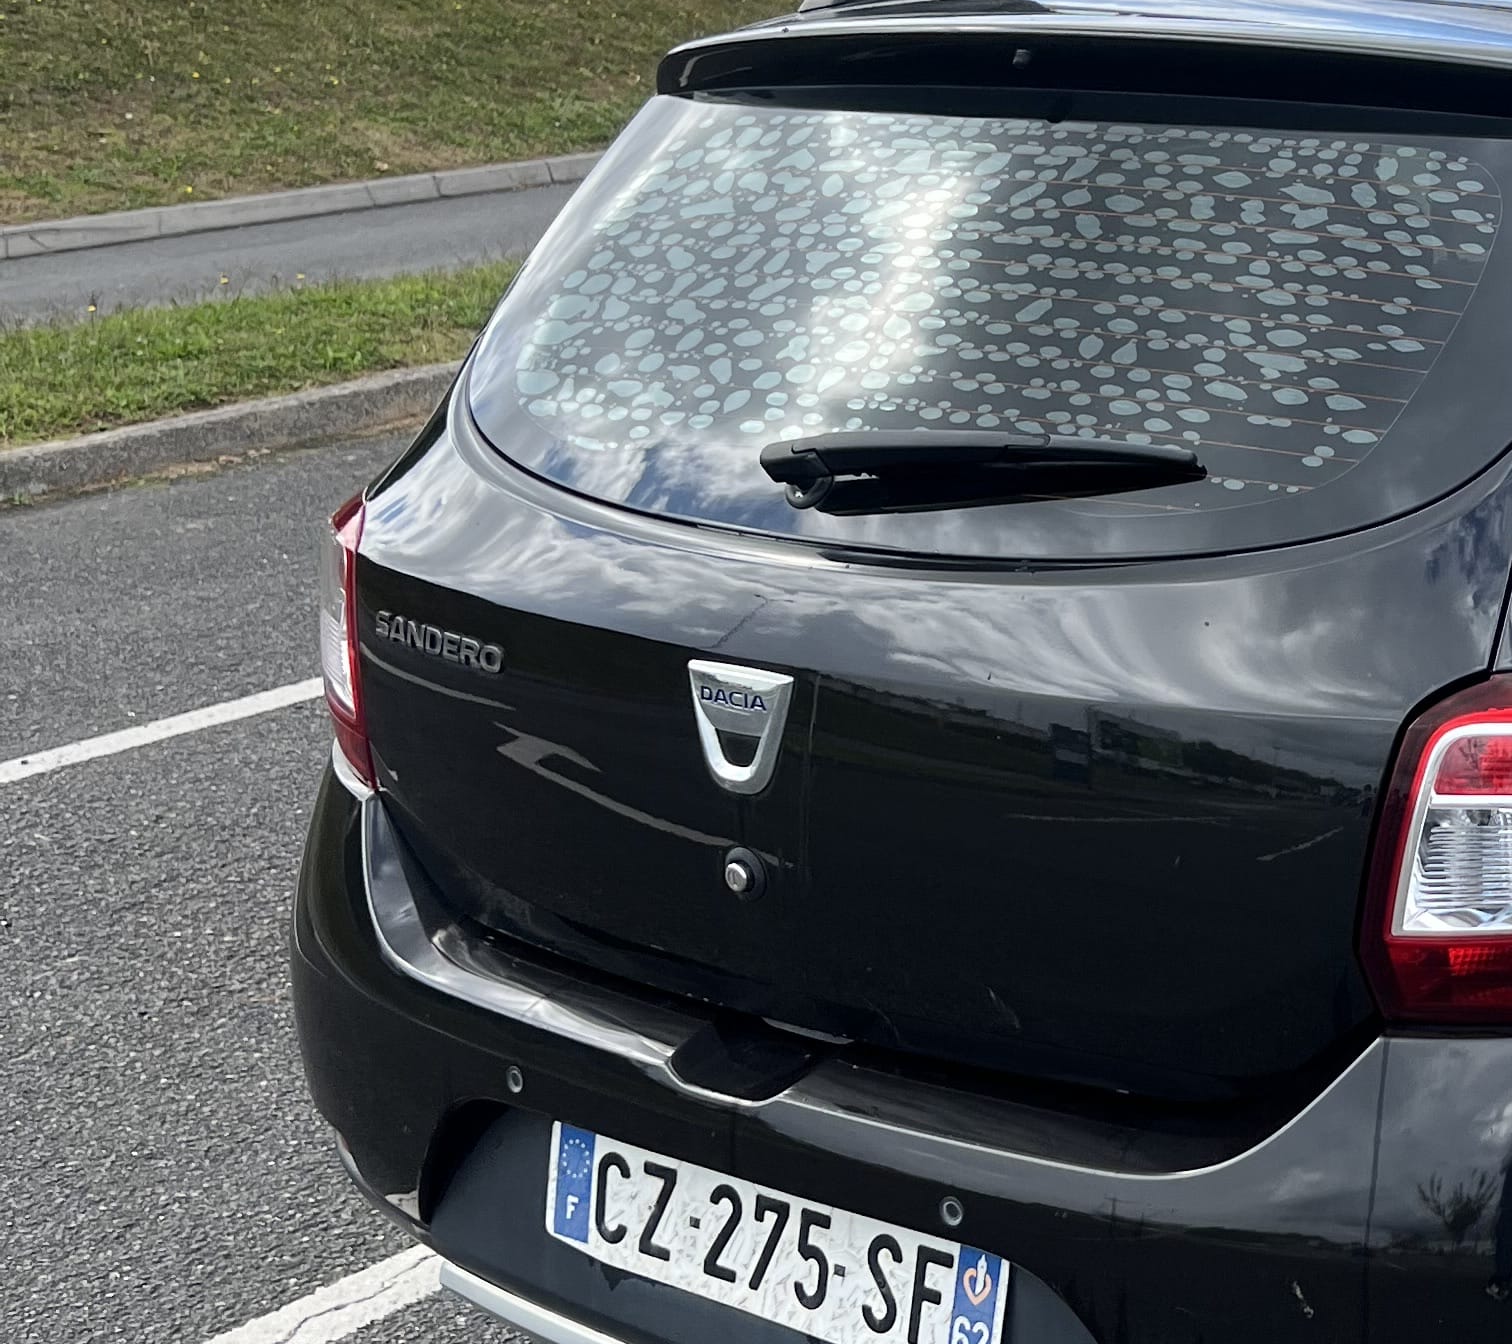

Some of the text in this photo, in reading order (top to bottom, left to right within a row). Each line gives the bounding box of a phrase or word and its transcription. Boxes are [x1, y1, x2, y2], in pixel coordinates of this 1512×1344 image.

[375, 610, 504, 675] SANDERO
[700, 684, 768, 713] DACIA
[565, 1194, 579, 1220] F
